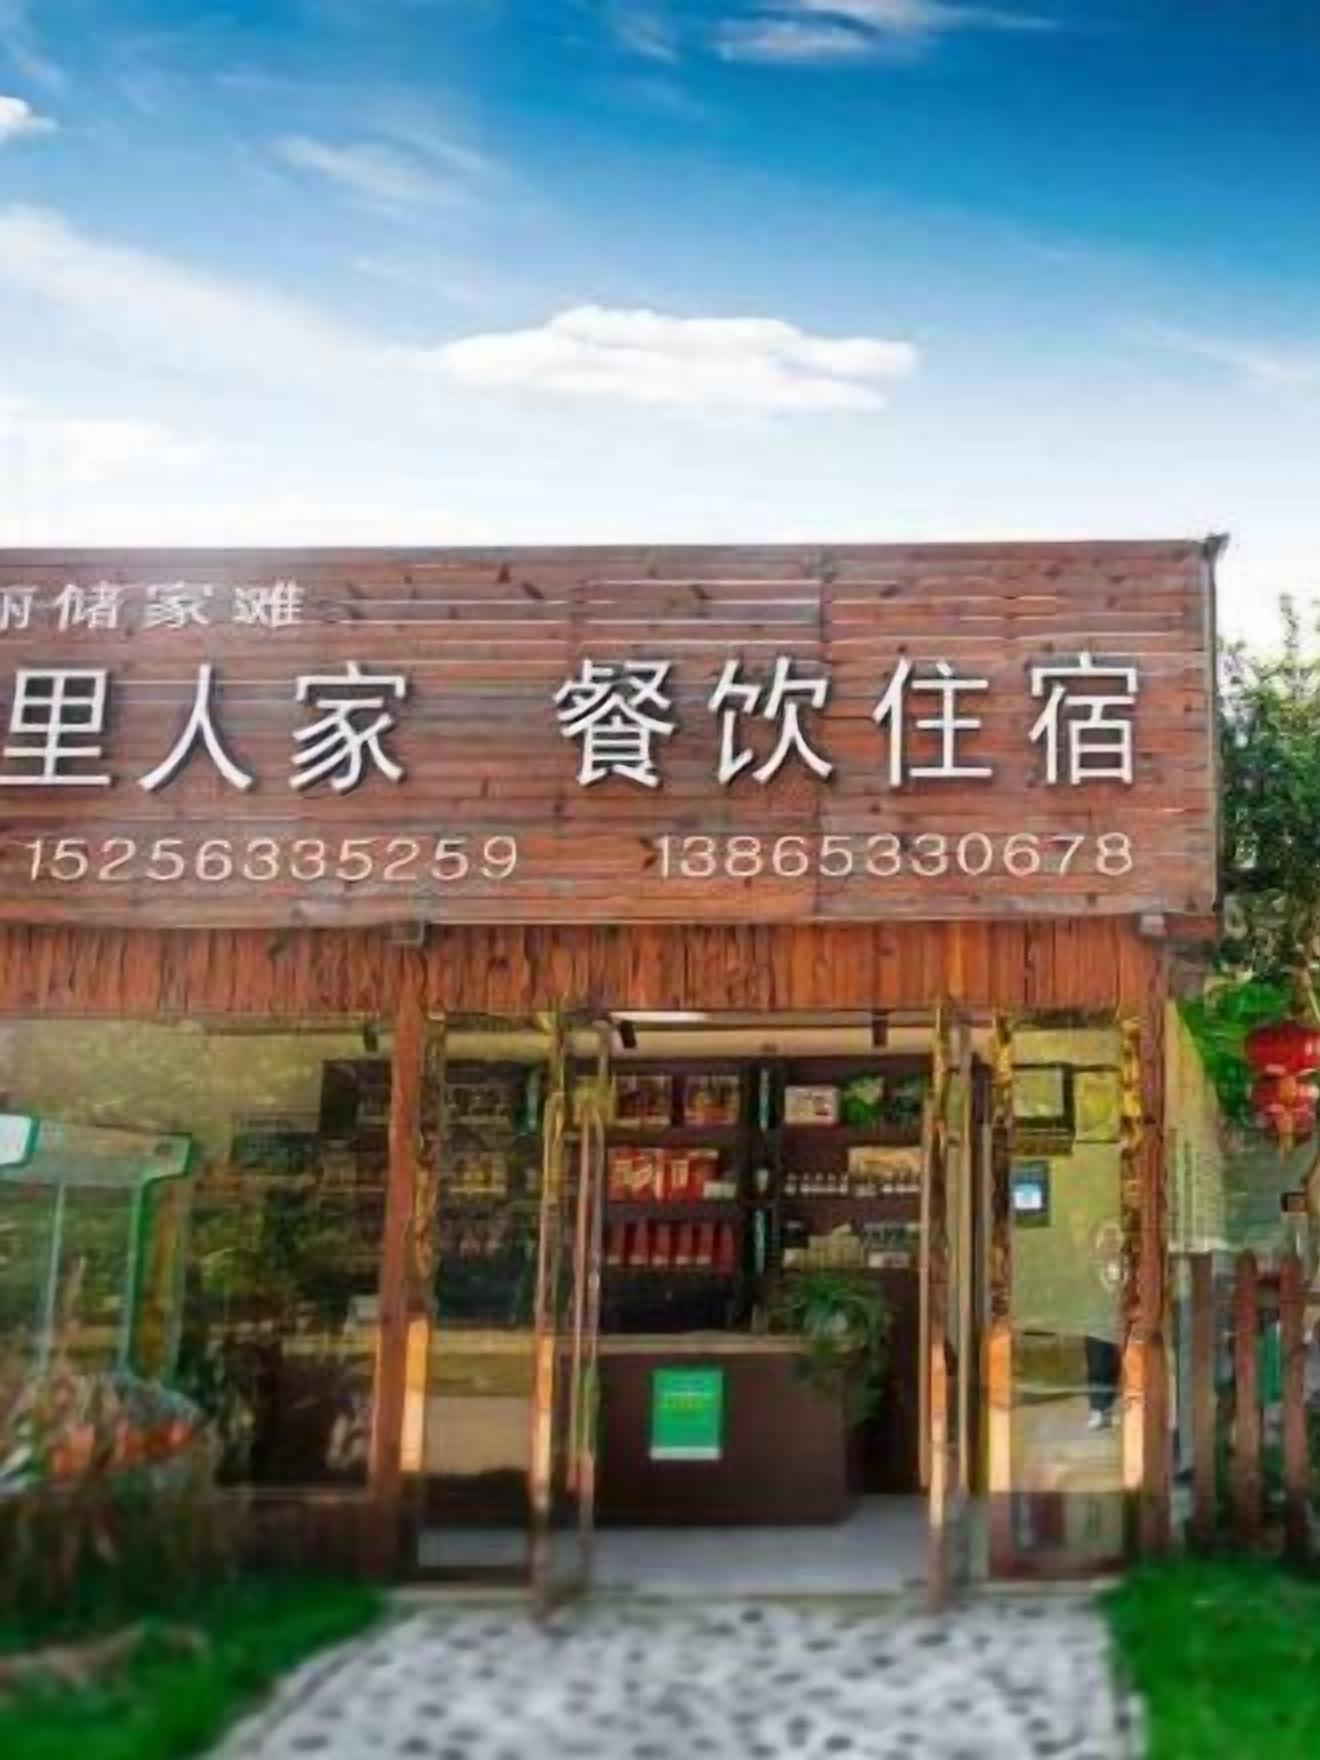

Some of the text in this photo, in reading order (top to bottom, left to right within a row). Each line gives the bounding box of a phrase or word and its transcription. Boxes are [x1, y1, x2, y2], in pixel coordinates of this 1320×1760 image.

[0, 652, 1142, 791] 里人家 餐饮住宿
[27, 832, 1134, 881] 15256335259 13865330678
